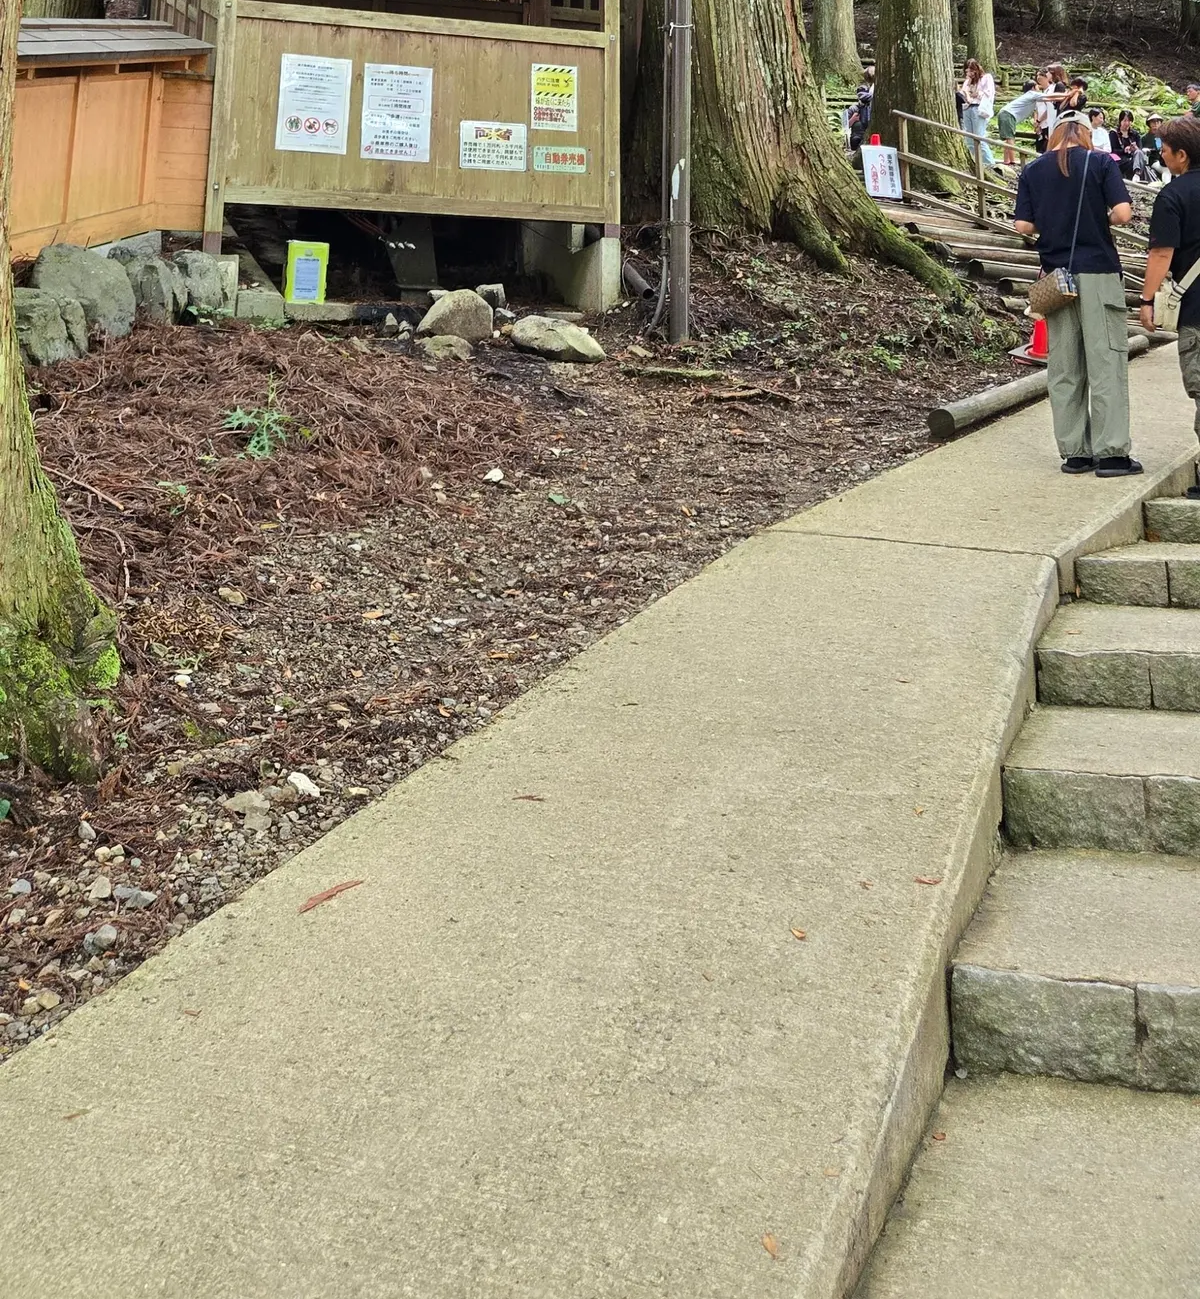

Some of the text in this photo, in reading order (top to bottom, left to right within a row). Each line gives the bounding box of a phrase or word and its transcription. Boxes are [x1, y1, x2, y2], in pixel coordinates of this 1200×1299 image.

[545, 152, 584, 165] 自動券売機
